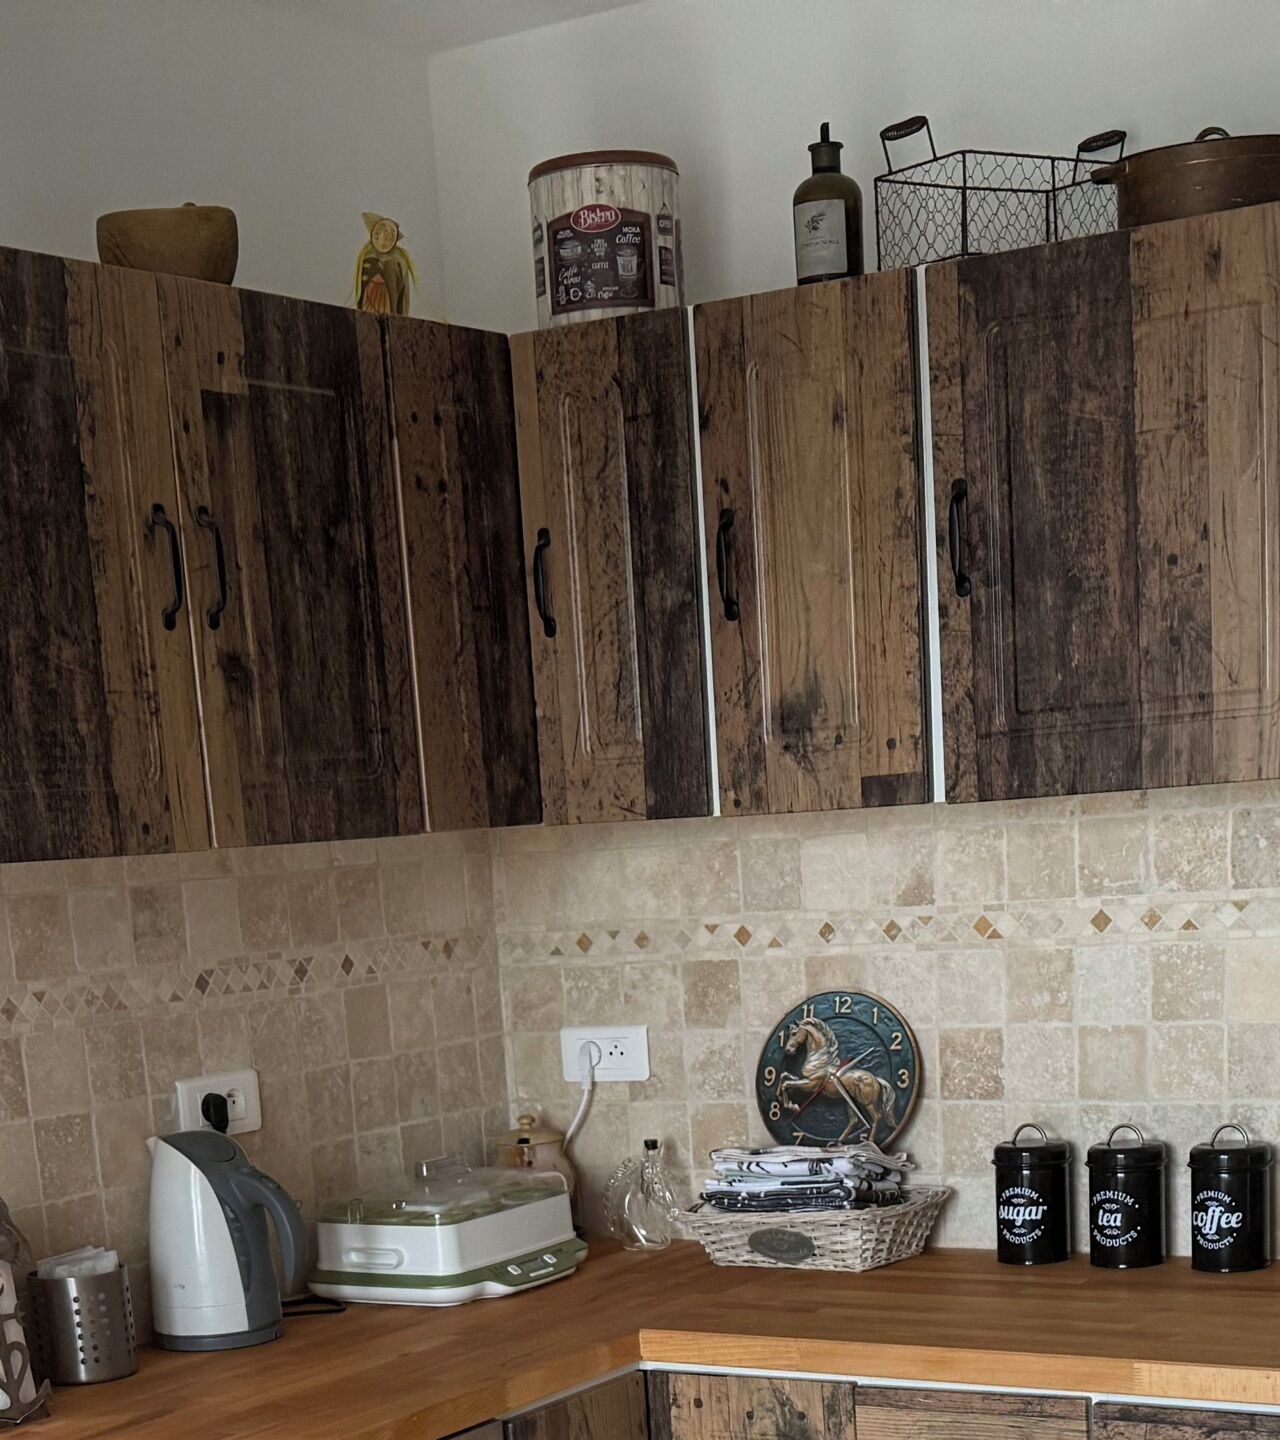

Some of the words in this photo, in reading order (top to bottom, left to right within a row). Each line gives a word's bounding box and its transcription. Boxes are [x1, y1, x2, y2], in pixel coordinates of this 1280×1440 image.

[579, 208, 616, 229] Bistro
[802, 1004, 815, 1019] 11
[834, 996, 852, 1013] 12
[872, 1006, 879, 1025] 1
[889, 1032, 903, 1050] 2
[764, 1066, 777, 1087] 9
[897, 1069, 910, 1089] 3
[769, 1101, 781, 1121] 8
[792, 1131, 804, 1146] 7
[1001, 1186, 1039, 1200] PREMIUM
[1092, 1190, 1135, 1206] PREMIUM
[1196, 1190, 1232, 1204] PREMIUM
[998, 1204, 1048, 1226] sugar
[1098, 1208, 1122, 1227] tea
[1192, 1206, 1243, 1234] coffee
[1002, 1228, 1042, 1244] PRODUCTS
[1093, 1229, 1138, 1247] PRODUCTS
[1196, 1234, 1234, 1250] PRODUCTS
